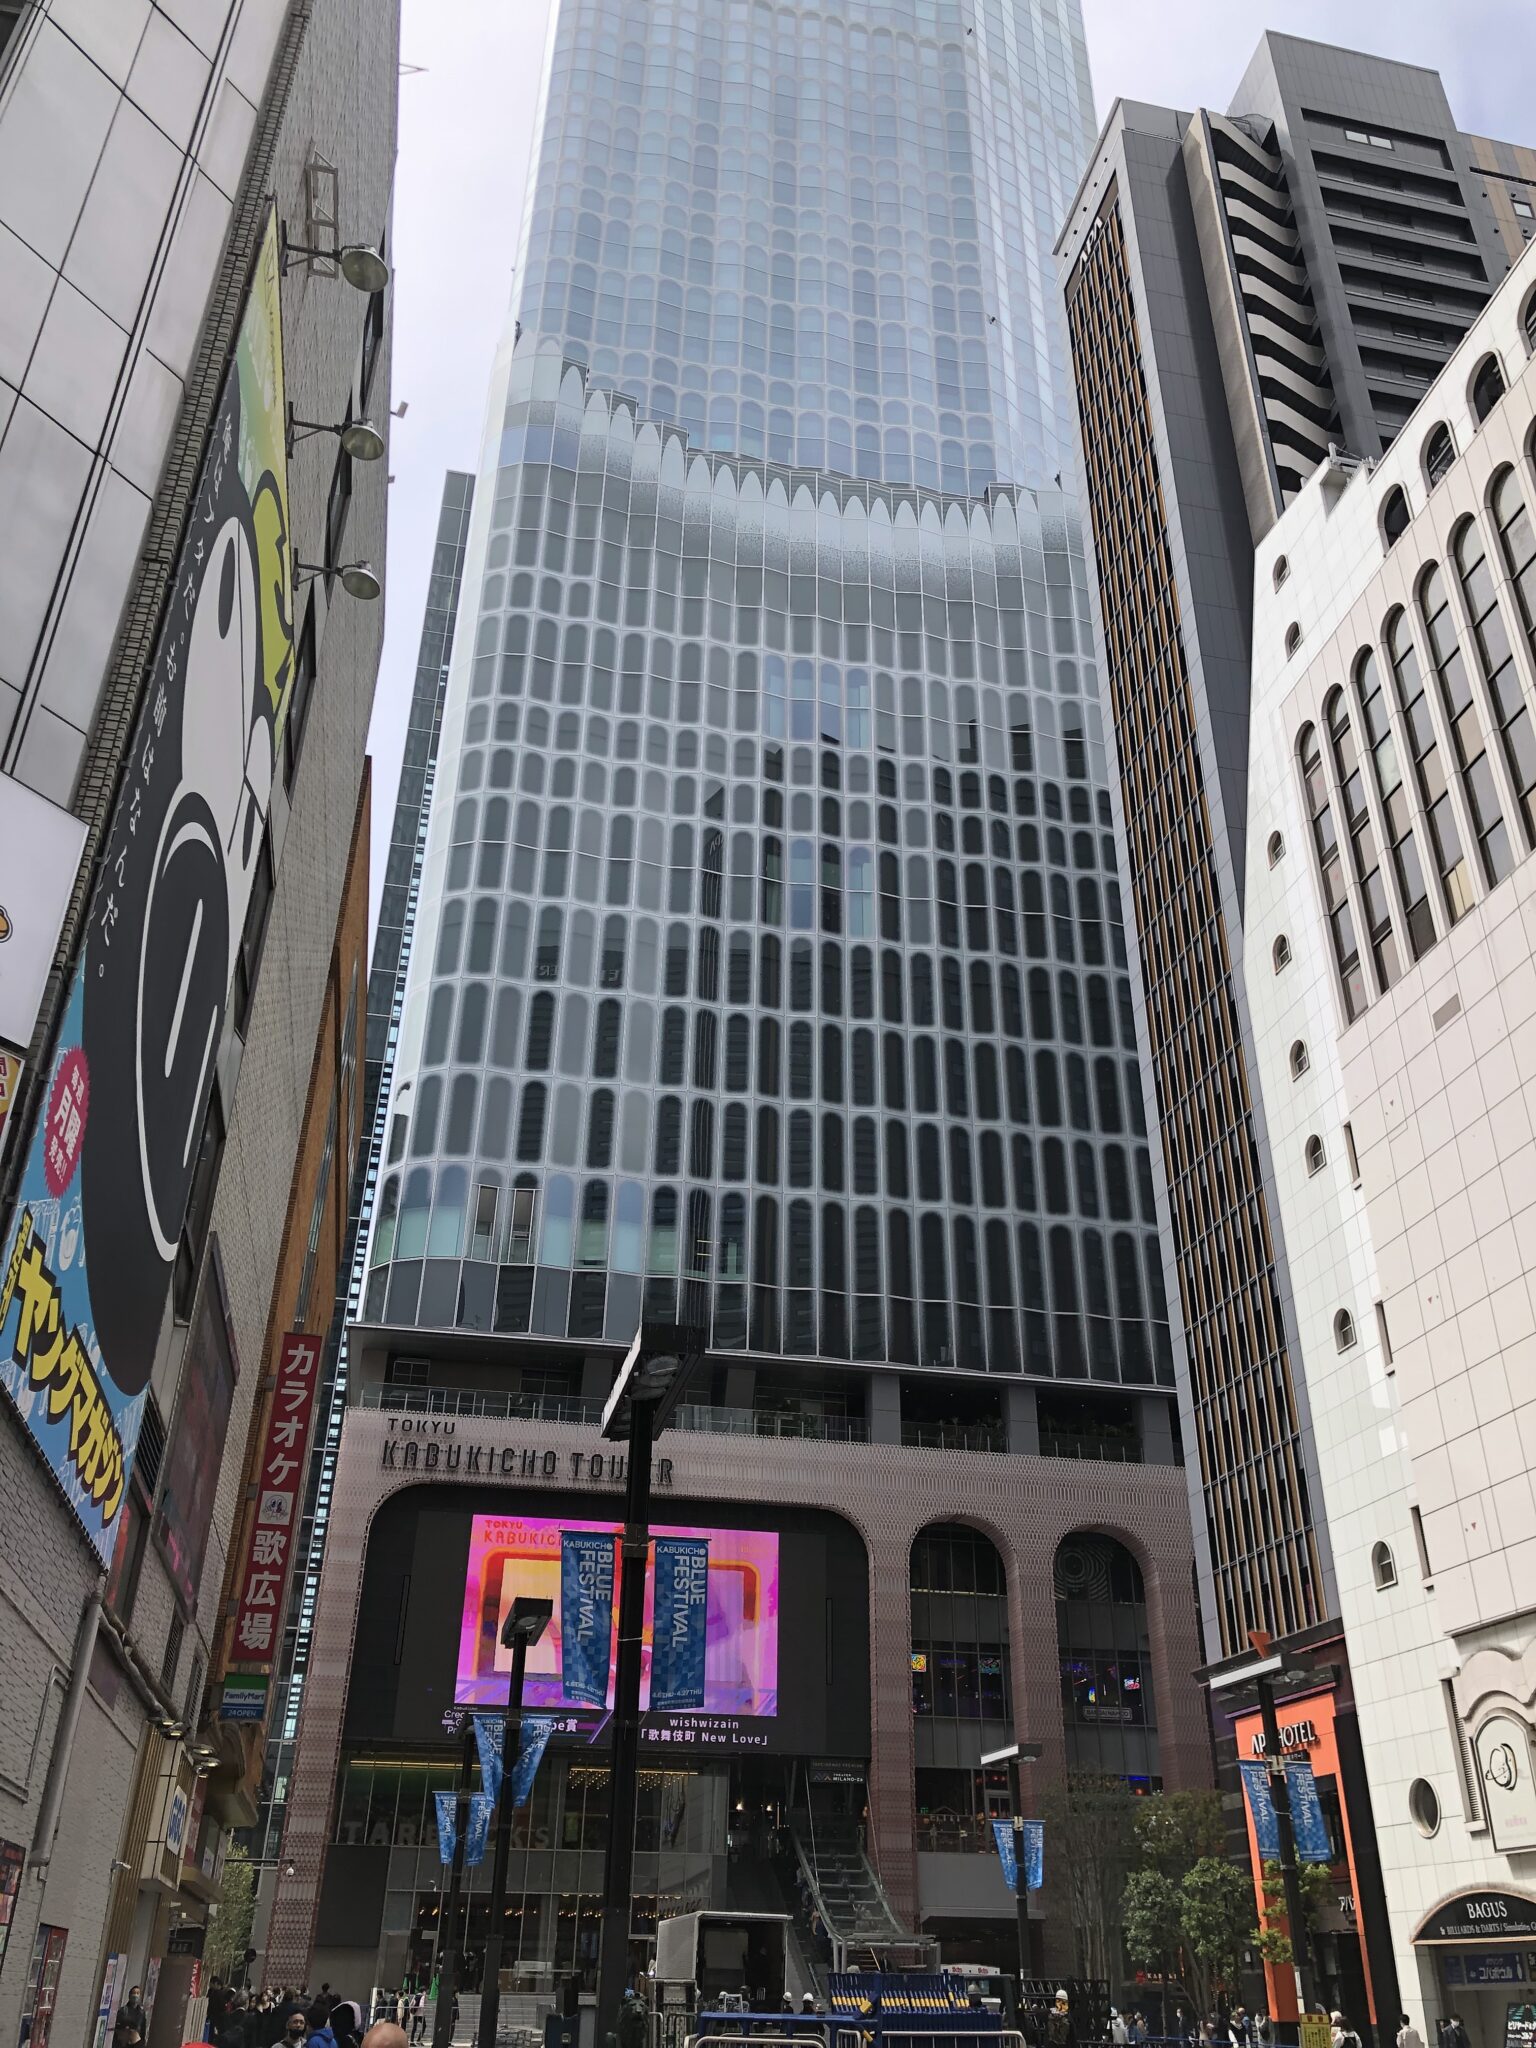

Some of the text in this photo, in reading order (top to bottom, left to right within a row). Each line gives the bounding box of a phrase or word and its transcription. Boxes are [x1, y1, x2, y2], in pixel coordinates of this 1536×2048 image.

[54, 1084, 82, 1162] 月曜
[14, 1242, 126, 1523] ヤングマガジン
[266, 1344, 315, 1486] カラオケ
[387, 1417, 456, 1435] TOKYU
[381, 1440, 674, 1485] KABUKICHO TOWR
[484, 1530, 561, 1547] KABUKIC
[485, 1519, 523, 1530] TOKYU
[563, 1539, 613, 1551] KABUKICHO
[656, 1545, 706, 1557] KABUKICHO
[237, 1528, 288, 1651] 歌広場
[595, 1550, 613, 1602] BLUE
[690, 1556, 706, 1606] BLUE
[577, 1549, 597, 1642] FESTIVAL
[672, 1554, 690, 1648] FESTIVAL
[224, 1691, 265, 1702] FamilyMart
[669, 1717, 740, 1729] wishwizain
[701, 1732, 727, 1743] New
[1251, 1733, 1266, 1755] AP
[1249, 1770, 1270, 1824] FESTIVAL
[1257, 1770, 1271, 1801] BLUE
[1296, 1772, 1314, 1826] FESTIVAL
[1304, 1770, 1319, 1802] BLUE
[1466, 1900, 1508, 1919] BAGUS
[1481, 1923, 1500, 1933] DARTS
